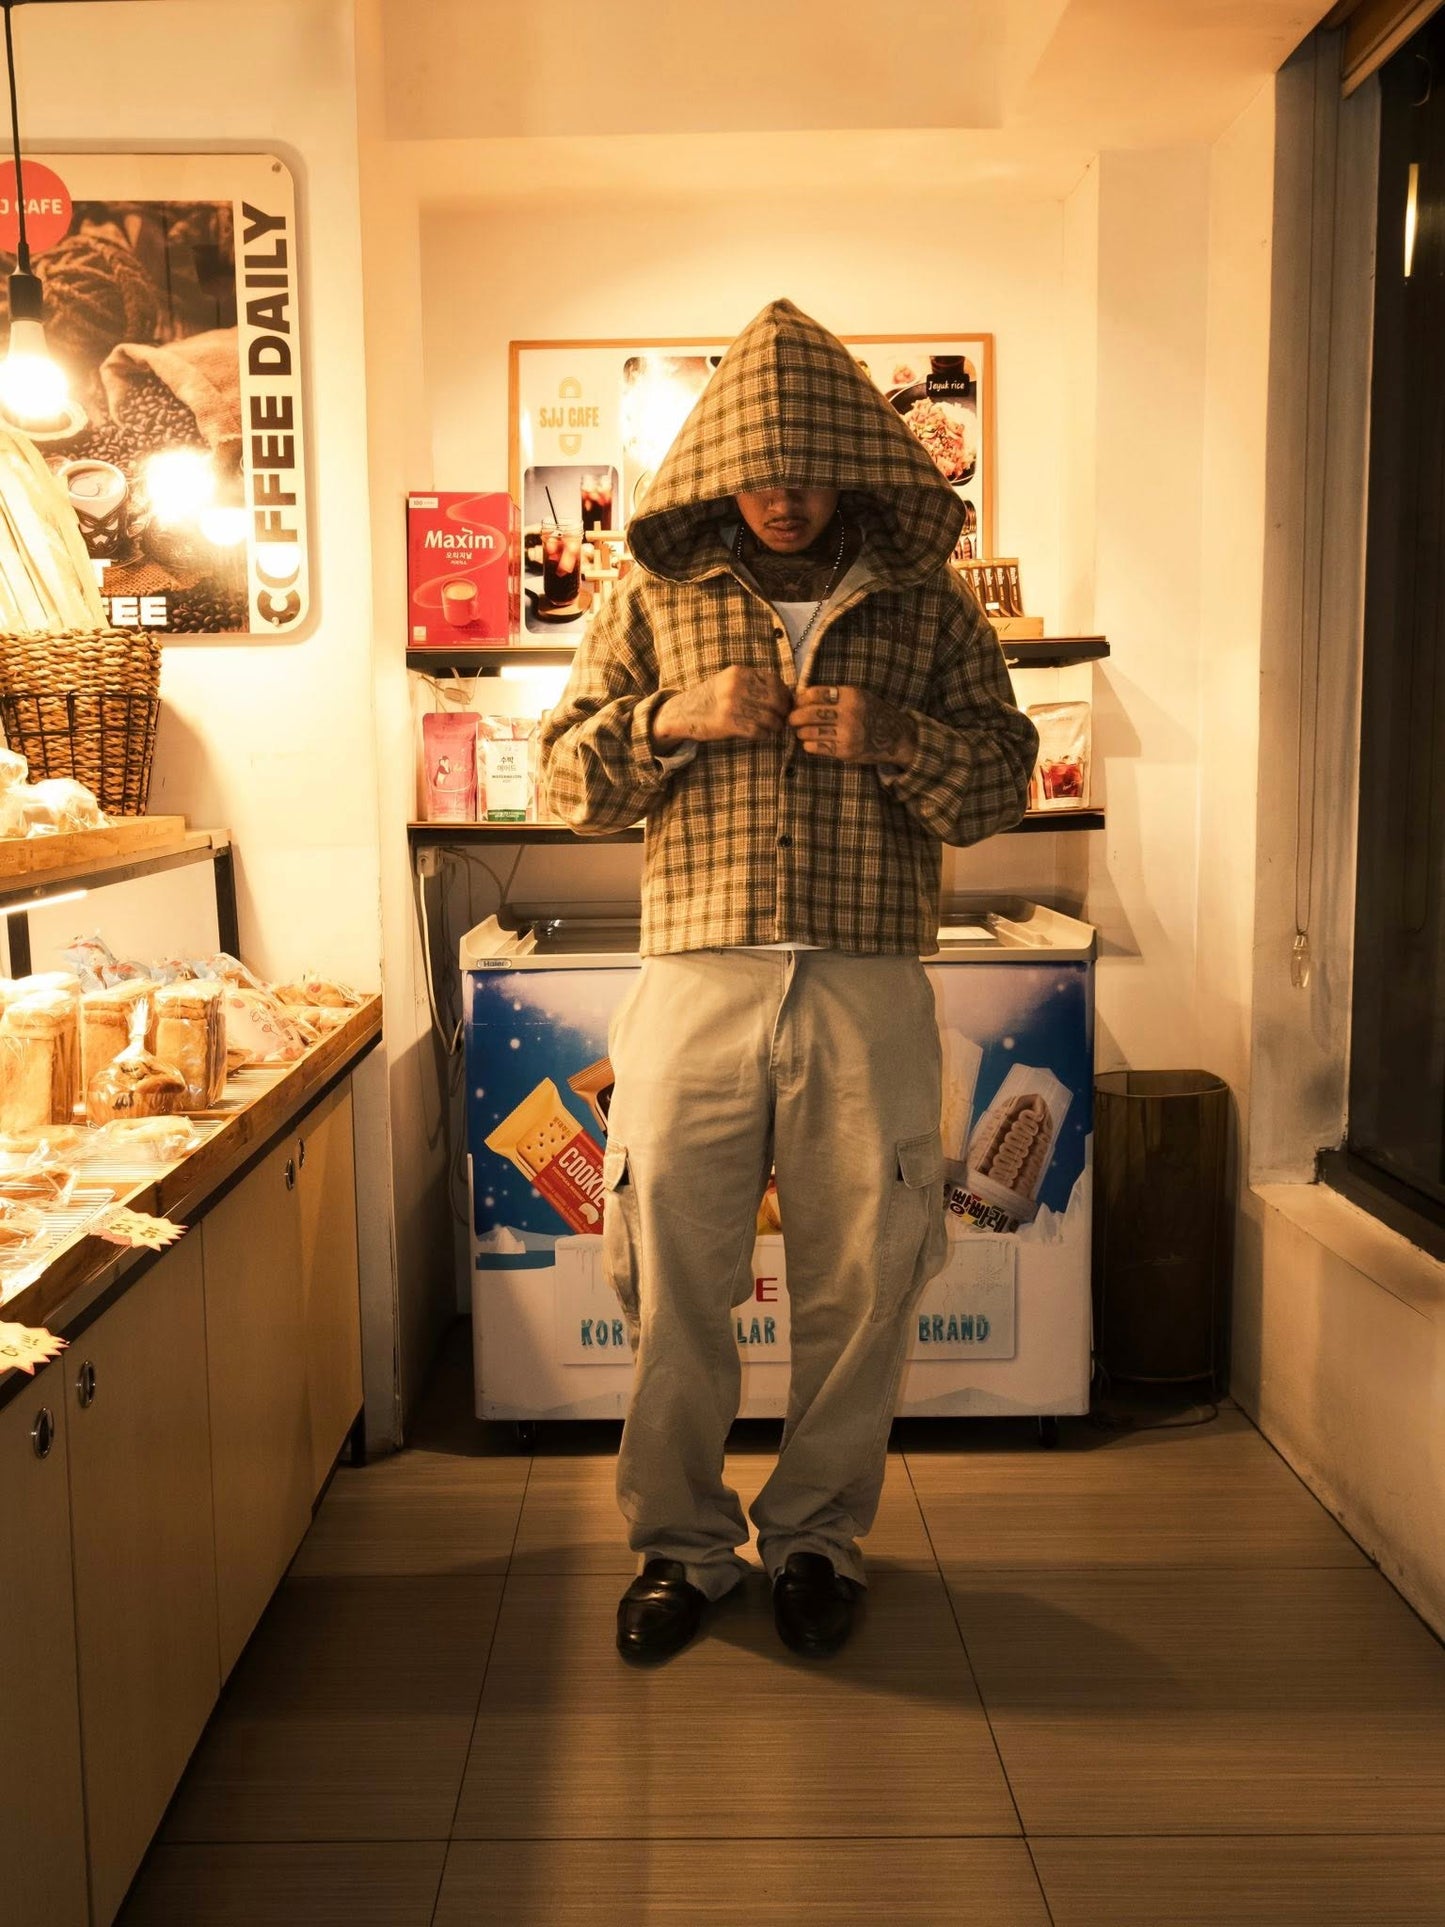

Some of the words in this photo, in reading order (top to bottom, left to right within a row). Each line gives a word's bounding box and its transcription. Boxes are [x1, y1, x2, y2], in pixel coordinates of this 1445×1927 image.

[242, 201, 293, 376] DAILY
[928, 380, 949, 392] Jeyuk
[951, 380, 965, 390] rice
[540, 407, 564, 428] SJJ
[568, 407, 599, 428] CAFE
[424, 527, 495, 549] Maxim
[918, 1313, 991, 1343] BRAND
